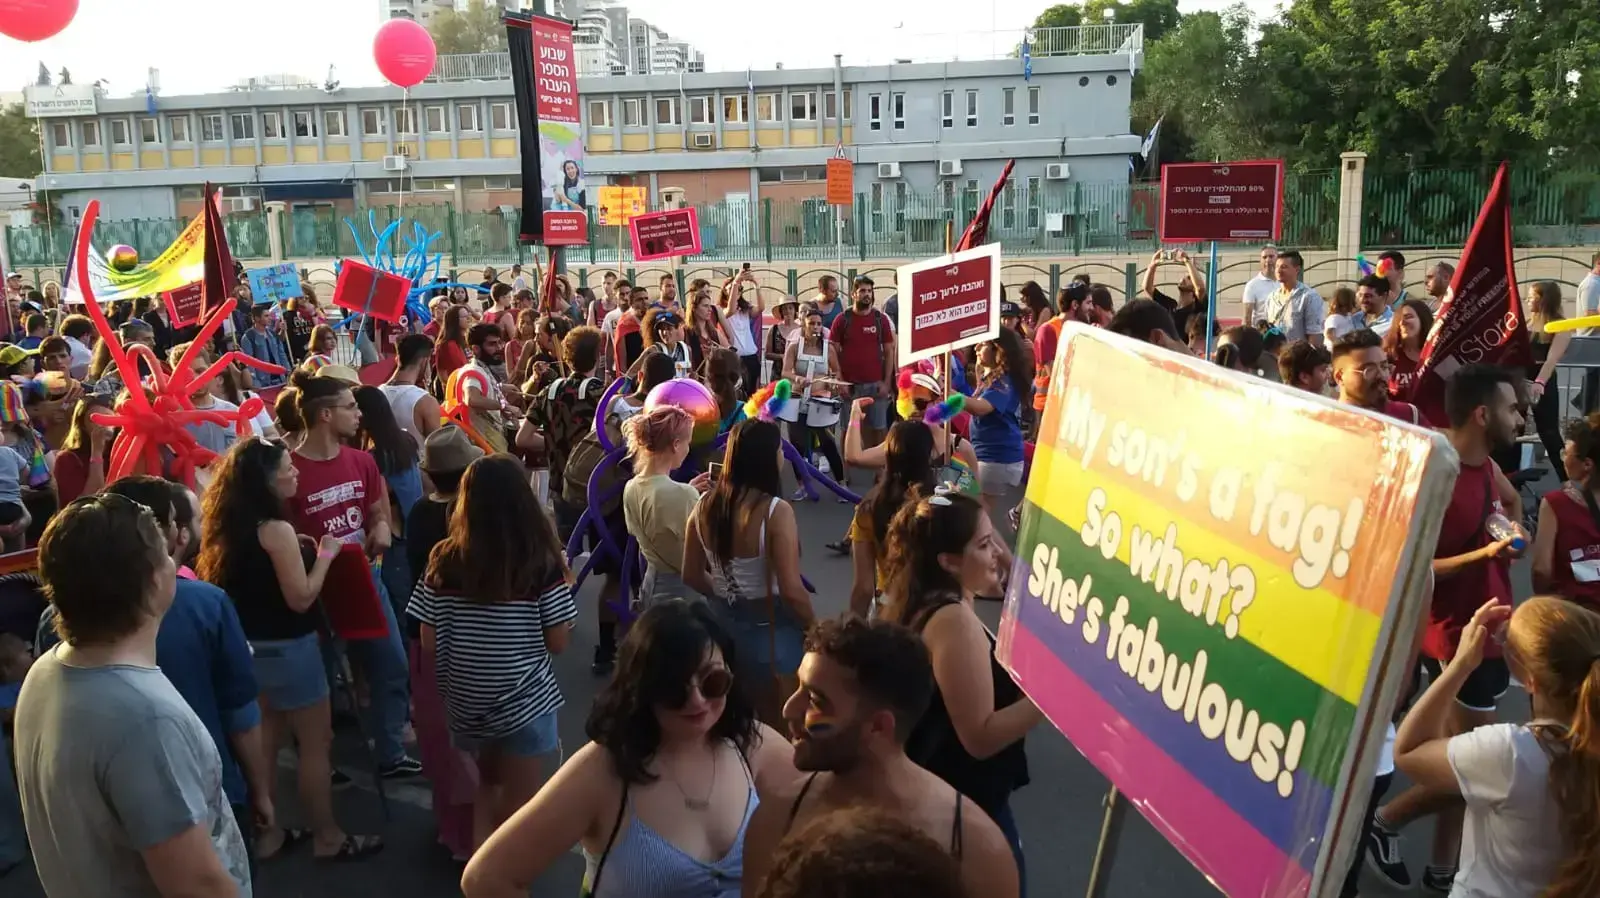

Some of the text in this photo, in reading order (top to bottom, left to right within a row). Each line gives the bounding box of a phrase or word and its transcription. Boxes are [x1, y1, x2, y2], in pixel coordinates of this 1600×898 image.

[540, 46, 566, 60] שבוע
[540, 61, 569, 77] הספר
[540, 78, 571, 93] העברי
[920, 280, 985, 304] ואהבת לרעך כמוך
[917, 301, 986, 328] גם אם הוא לא כמוך
[1060, 386, 1364, 589] My son's a fag!
[323, 514, 347, 532] איגי
[1081, 487, 1256, 639] So what?
[1028, 542, 1306, 798] She's fabulous!
